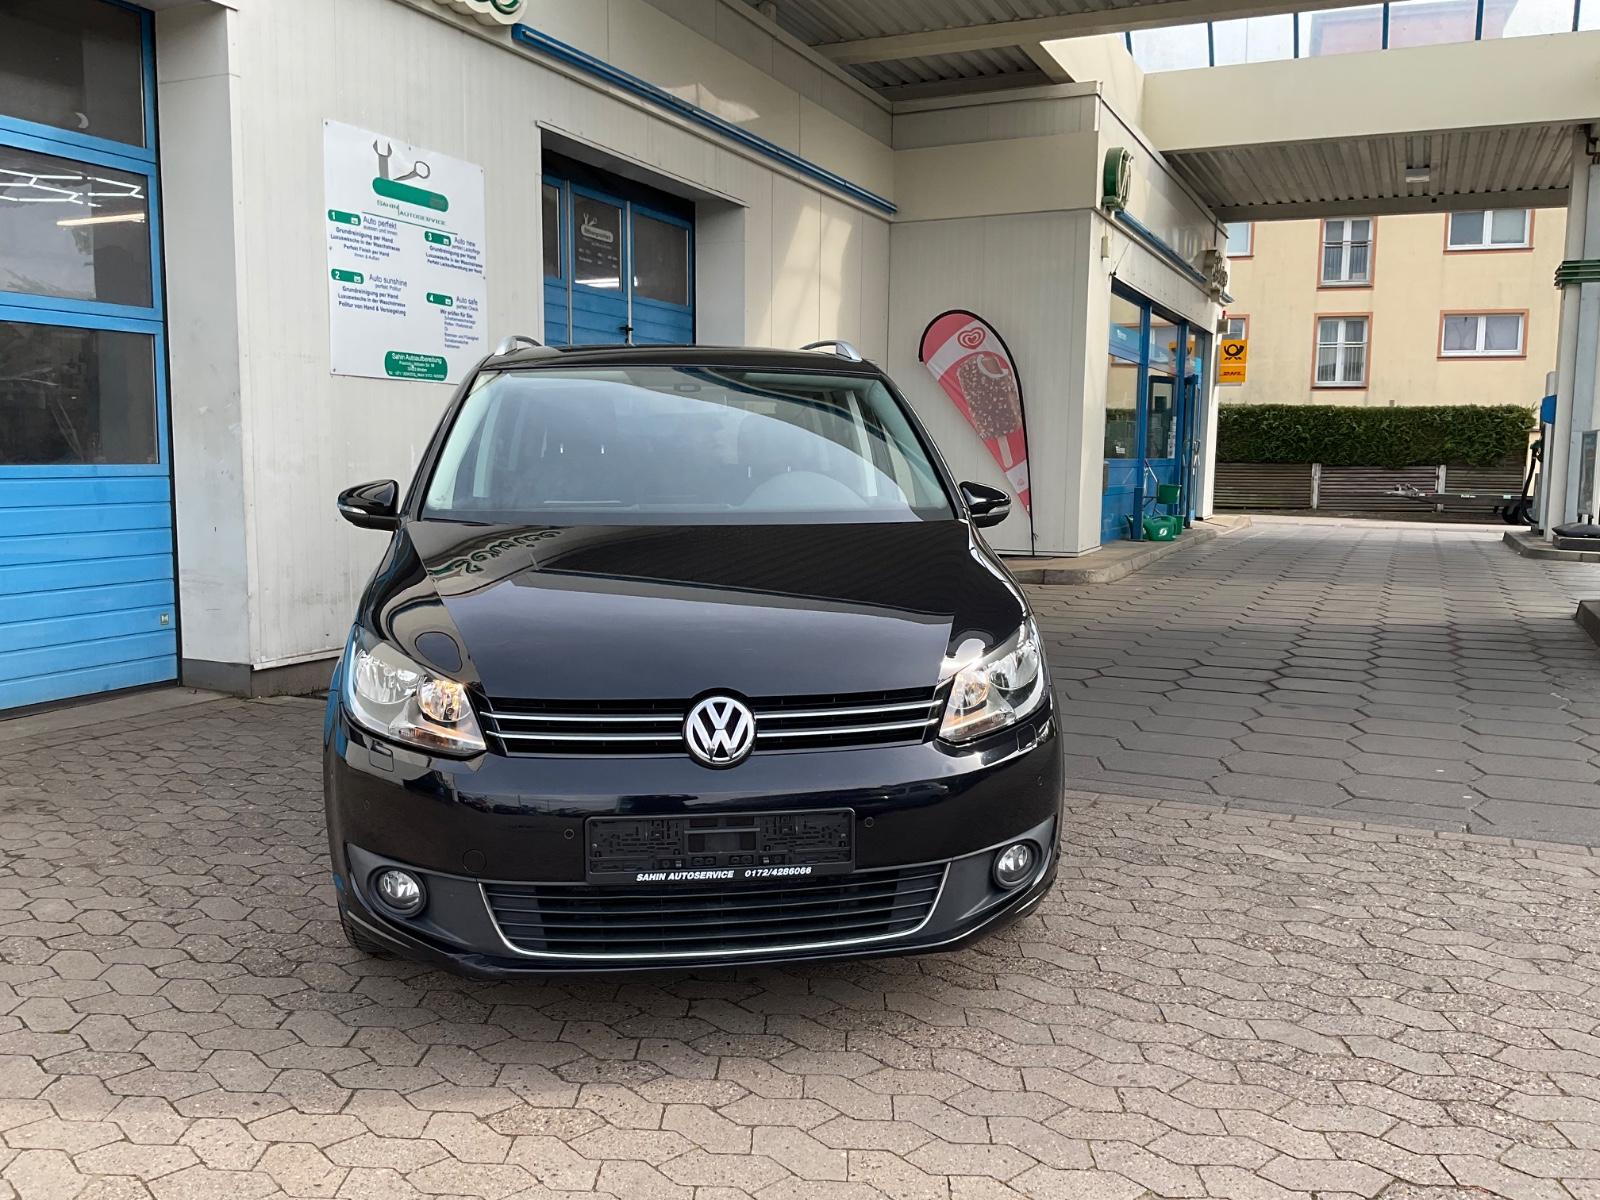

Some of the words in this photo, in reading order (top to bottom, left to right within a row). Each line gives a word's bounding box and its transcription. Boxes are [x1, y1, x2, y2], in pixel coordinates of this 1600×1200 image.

[331, 211, 336, 220] 1
[363, 215, 377, 226] Auto
[378, 218, 397, 229] perfekt
[335, 226, 372, 240] Grundreinigung
[381, 236, 393, 244] Hand
[335, 270, 341, 280] 2
[368, 273, 382, 283] Auto
[383, 277, 407, 288] sunshine
[342, 285, 378, 298] Grundreinigung
[387, 292, 399, 300] Hand
[363, 303, 375, 311] Hand
[391, 352, 405, 361] Sahin
[636, 872, 666, 882] SAHIN
[667, 869, 734, 881] AUTOSERVICE
